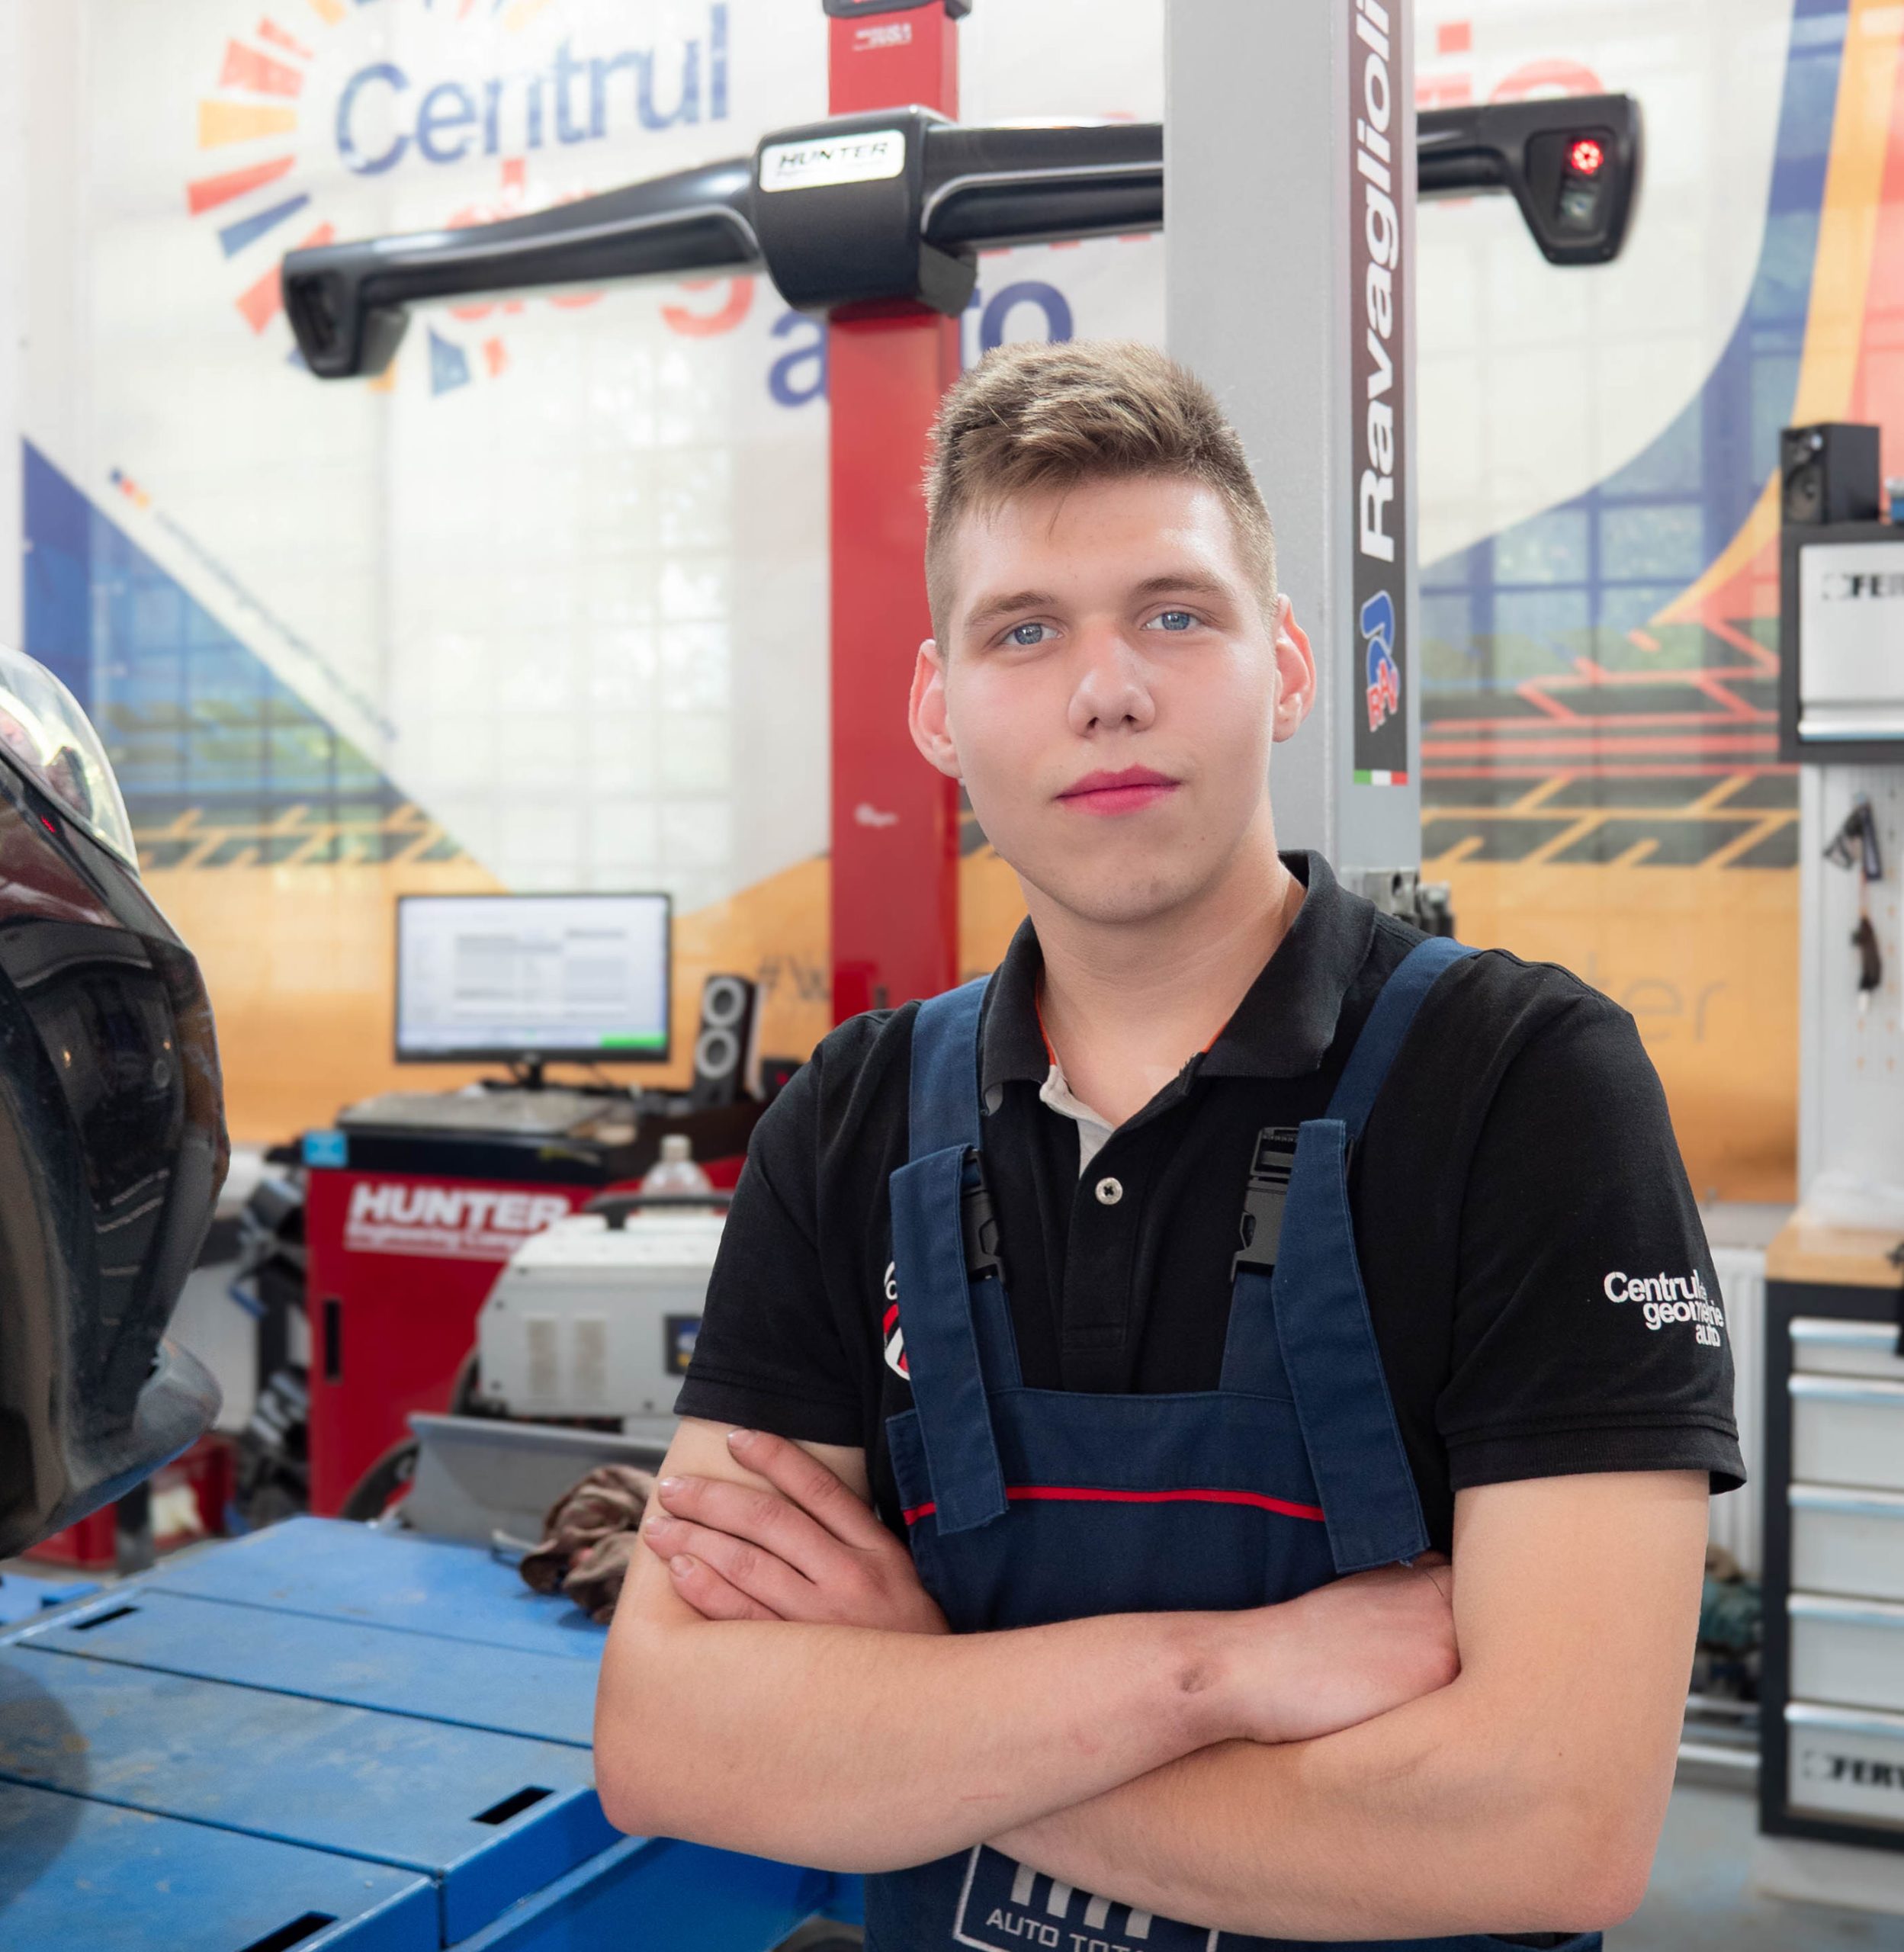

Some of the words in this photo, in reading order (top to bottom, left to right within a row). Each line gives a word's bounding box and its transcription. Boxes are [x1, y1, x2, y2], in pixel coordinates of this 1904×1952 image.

[334, 2, 730, 176] Centrul
[779, 141, 891, 169] HUNTER
[346, 1181, 570, 1234] HUNTER
[1604, 1269, 1700, 1303] Centrul
[1695, 1324, 1721, 1347] auto
[985, 1908, 1060, 1948] AUTO
